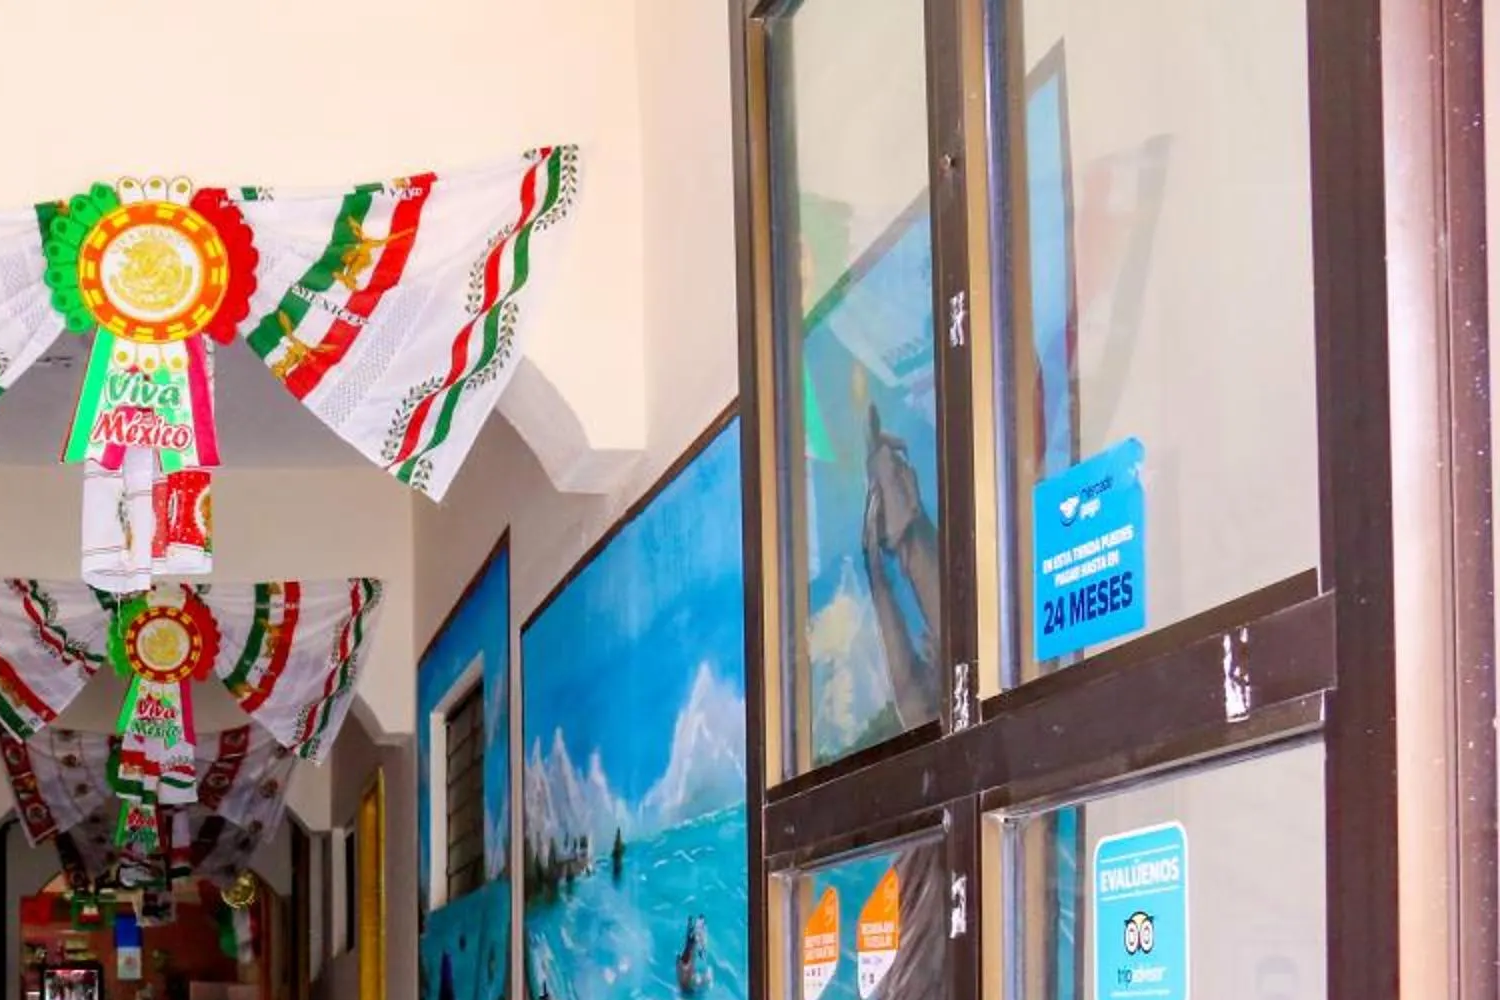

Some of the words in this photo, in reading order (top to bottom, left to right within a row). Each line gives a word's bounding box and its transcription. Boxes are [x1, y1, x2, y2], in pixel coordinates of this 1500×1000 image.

[107, 372, 181, 405] Viva
[1043, 596, 1065, 635] 24
[1069, 571, 1133, 626] MESES
[1101, 857, 1179, 893] EVALÚENOS
